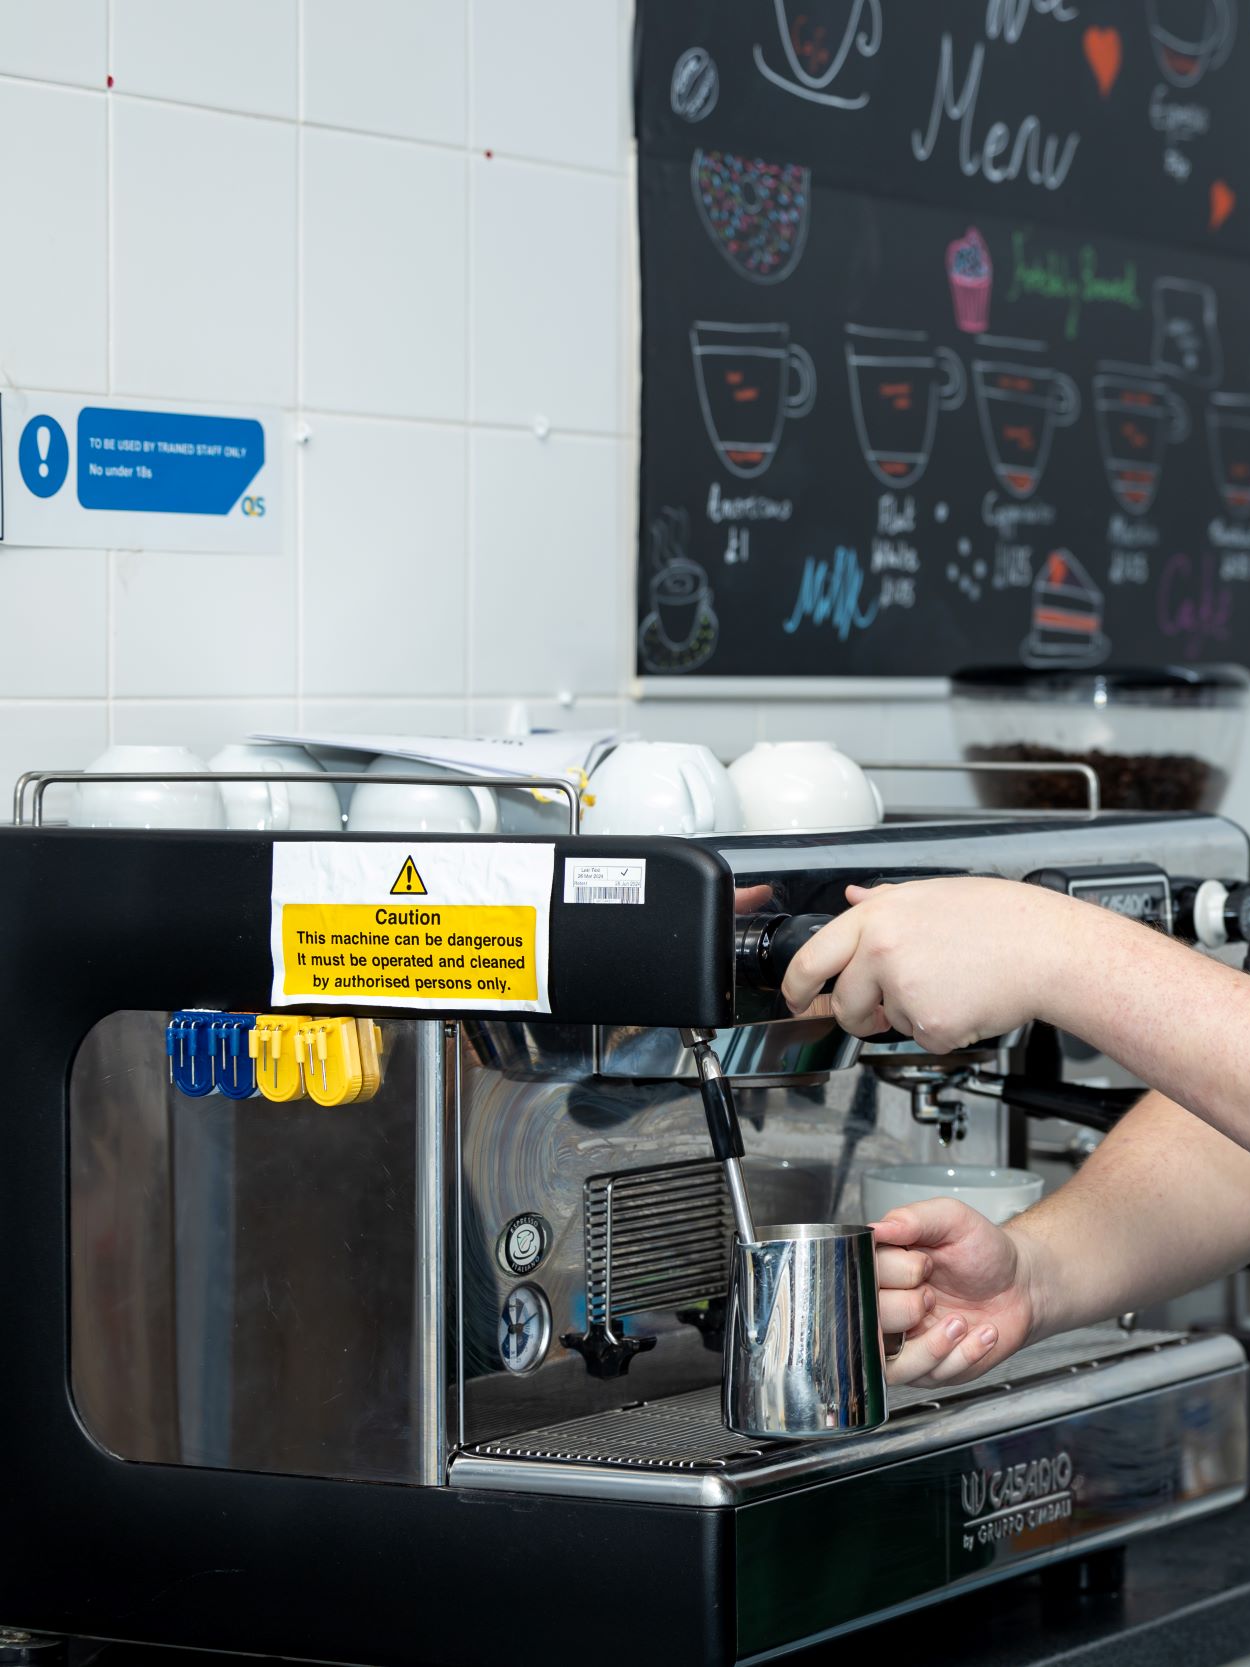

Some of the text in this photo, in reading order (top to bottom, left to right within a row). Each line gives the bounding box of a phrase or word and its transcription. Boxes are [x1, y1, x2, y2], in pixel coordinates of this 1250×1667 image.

[911, 31, 1082, 190] Menu
[89, 437, 248, 459] TO BE USED BY TRAINED STAFF ONLY
[89, 462, 153, 480] No under 18s
[375, 908, 441, 926] Caution
[297, 931, 523, 950] This machine can be dangerous
[297, 952, 525, 970] It must be operated and cleaned
[313, 974, 511, 994] by authorised persons only.
[510, 1217, 539, 1234] ESPRESSO
[511, 1256, 540, 1273] ITALIANO
[989, 1451, 1072, 1510] CASADIO
[962, 1498, 1072, 1552] by GRUPPO CIMBALI
